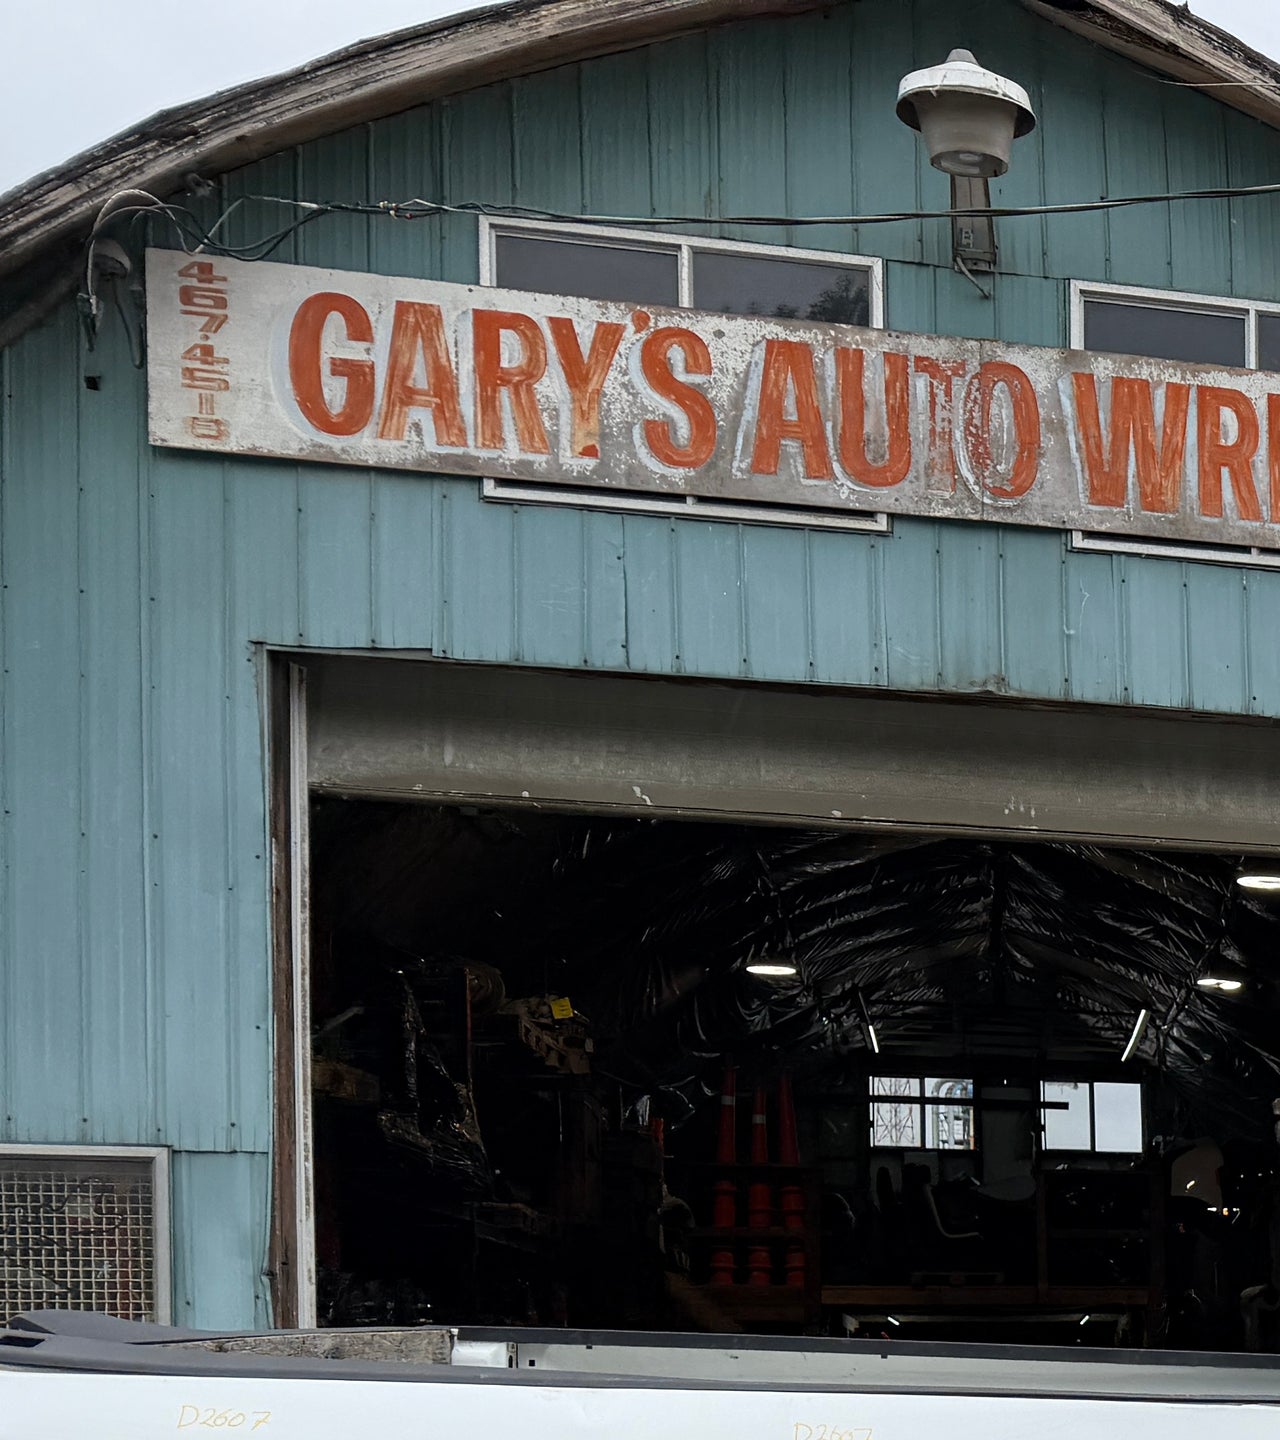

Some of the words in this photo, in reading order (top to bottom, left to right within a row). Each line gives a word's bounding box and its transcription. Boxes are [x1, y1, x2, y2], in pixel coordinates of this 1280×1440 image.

[289, 291, 717, 469] GARY'S
[751, 339, 1040, 498] AUTO
[177, 1405, 271, 1431] D2607
